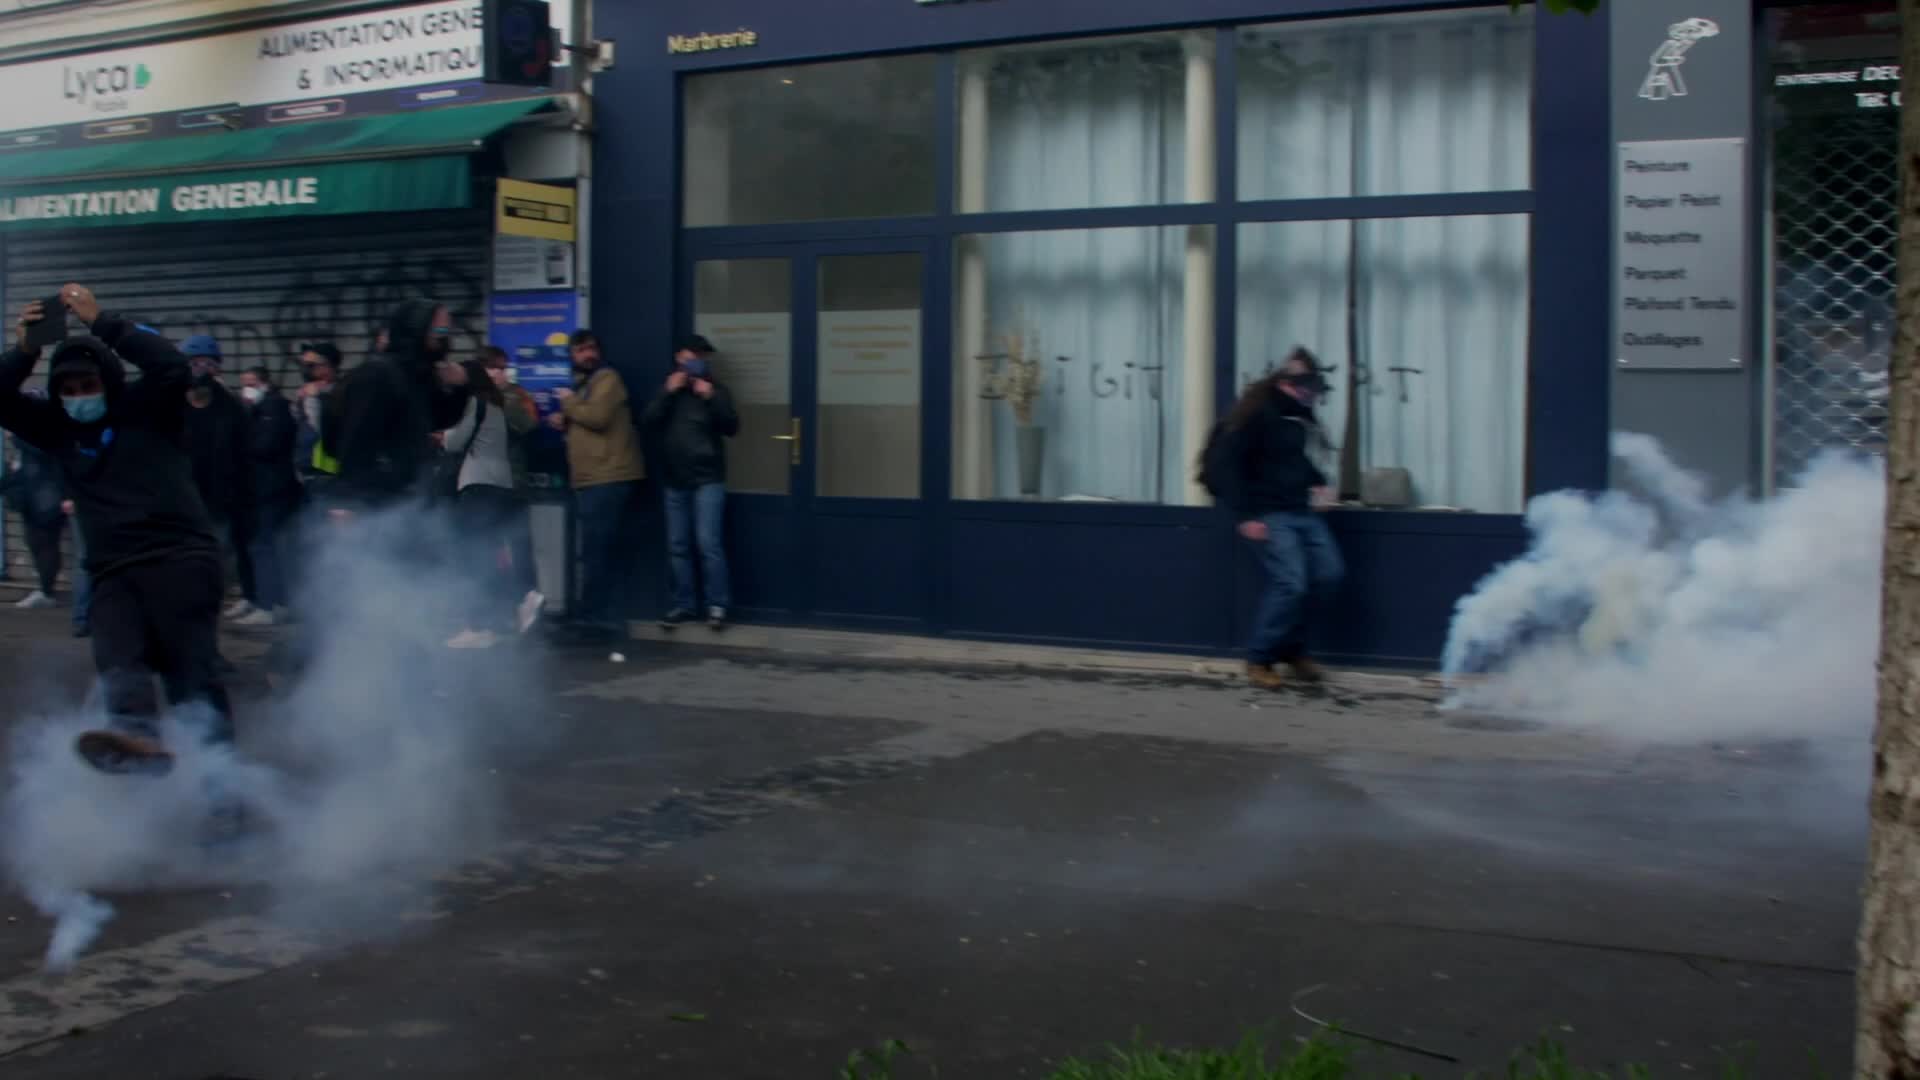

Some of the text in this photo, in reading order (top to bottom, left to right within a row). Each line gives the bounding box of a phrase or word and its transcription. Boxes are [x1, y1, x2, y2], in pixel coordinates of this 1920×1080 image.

[258, 15, 415, 59] ALIMENTATION
[666, 26, 759, 54] Marbrerie
[63, 65, 130, 105] Lyca
[297, 68, 312, 90] &
[1623, 159, 1690, 173] Peinture
[0, 177, 318, 222] LIMENTATION GENERALE
[1623, 192, 1722, 210] Papier Peint
[1623, 231, 1702, 246] Moquette
[1623, 265, 1687, 282] Parquet
